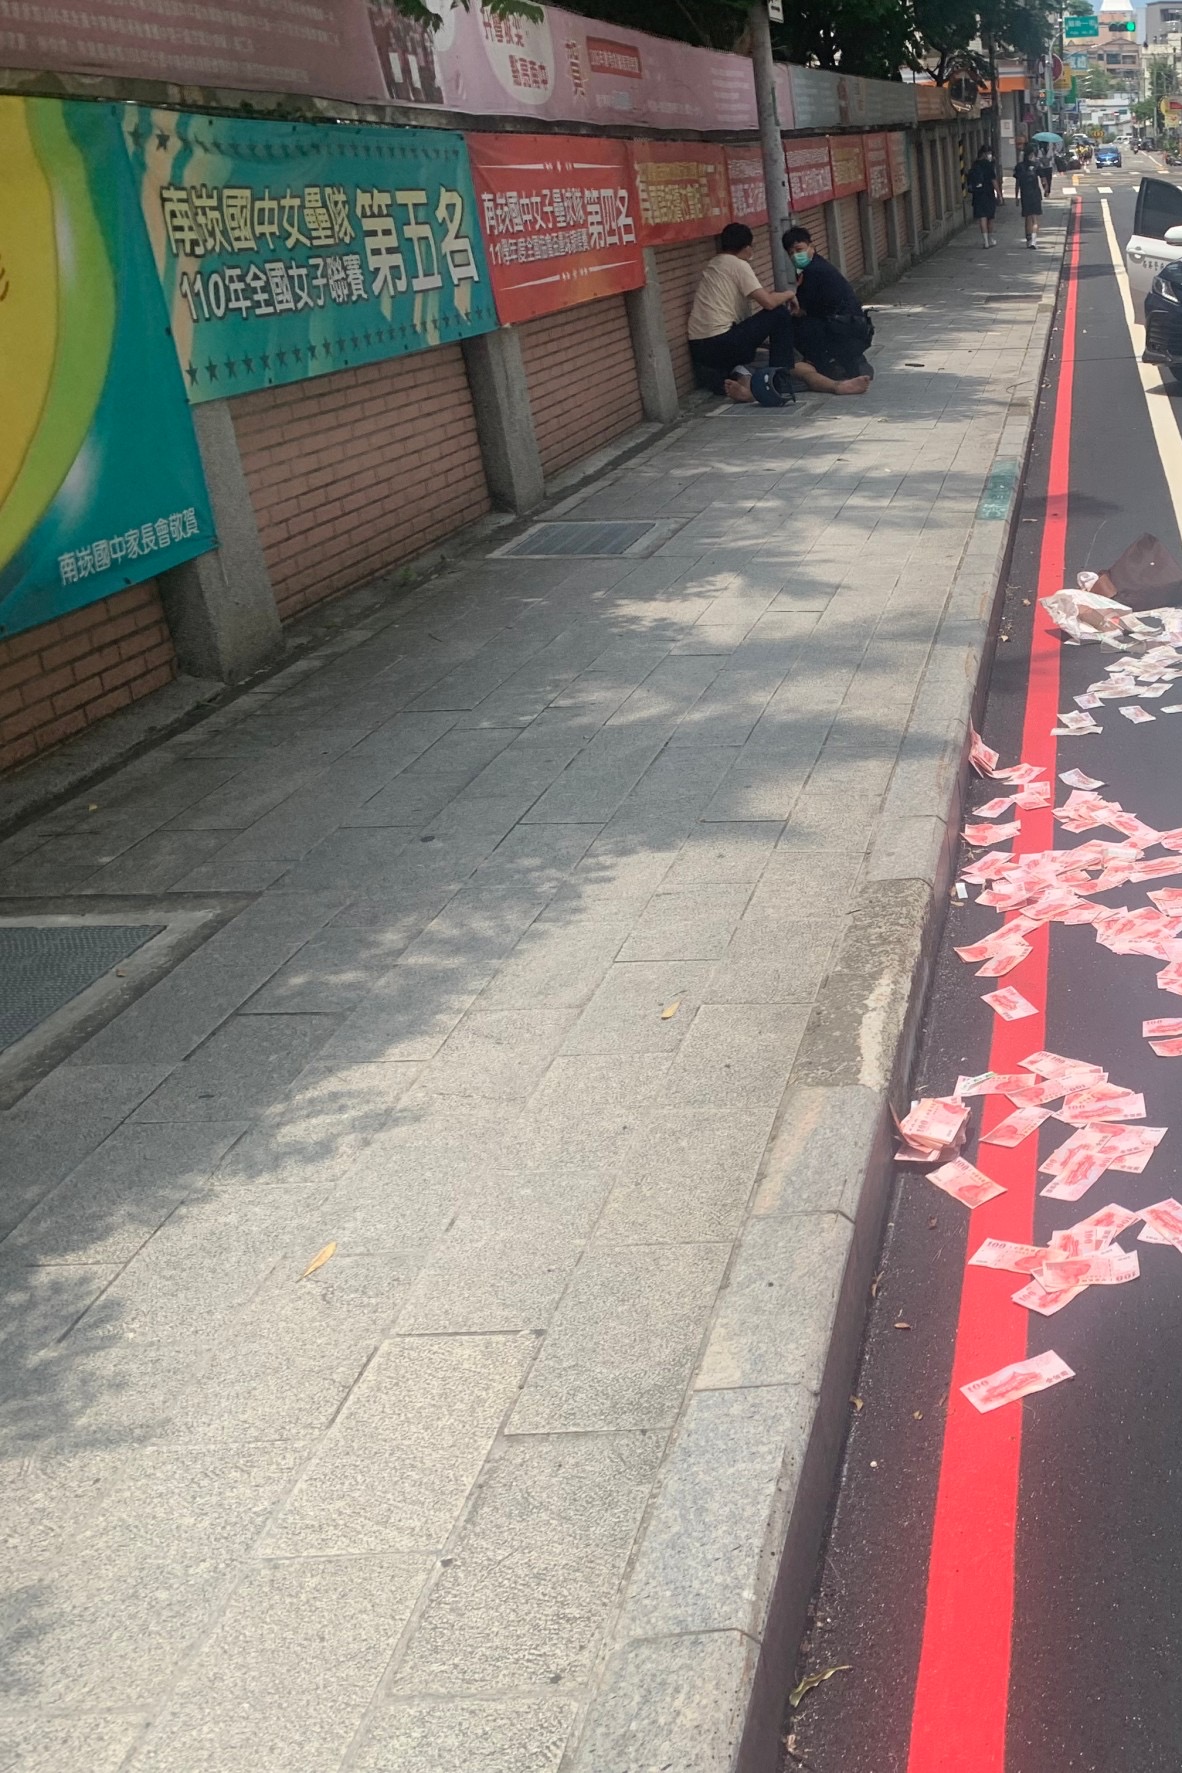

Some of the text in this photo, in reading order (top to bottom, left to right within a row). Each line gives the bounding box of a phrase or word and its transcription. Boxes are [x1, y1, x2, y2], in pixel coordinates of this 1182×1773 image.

[161, 183, 481, 298] 南崁國中女壘隊 第五名
[584, 186, 637, 250] 第四名
[180, 254, 368, 323] 110年全國女子聯賽
[58, 507, 200, 586] 南崁國中家長會敬賀
